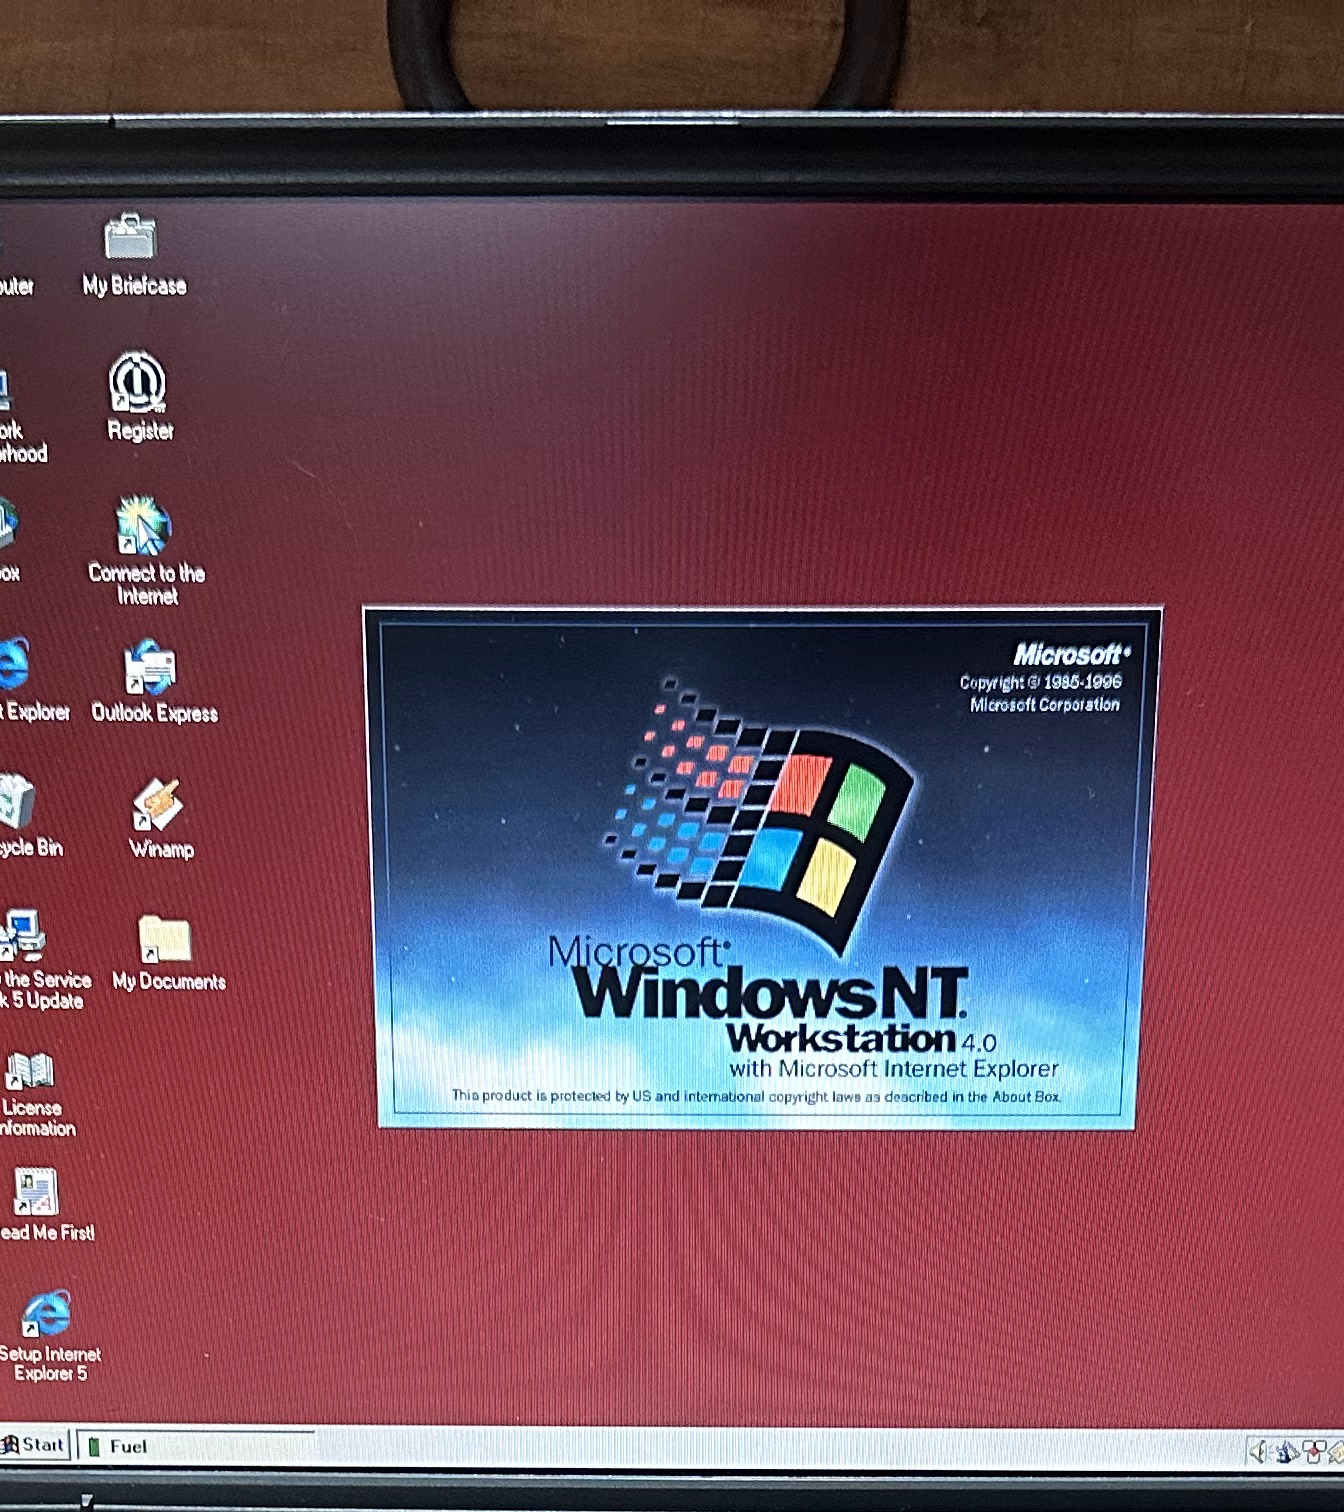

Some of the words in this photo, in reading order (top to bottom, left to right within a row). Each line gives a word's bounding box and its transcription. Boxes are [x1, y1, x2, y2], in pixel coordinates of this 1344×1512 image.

[83, 275, 107, 298] My
[112, 275, 187, 296] Briefcase
[107, 419, 174, 443] Register
[88, 561, 155, 583] Connect
[160, 563, 175, 583] to
[179, 562, 205, 583] the
[118, 586, 178, 606] Internet
[960, 673, 1025, 693] Copyright
[8, 702, 70, 725] Explorer
[92, 702, 153, 722] Outlook
[157, 702, 218, 725] Express
[970, 695, 1036, 712] Microsoft
[1039, 695, 1120, 714] Corporation
[37, 836, 64, 857] Bin
[128, 838, 194, 860] Winamp
[5, 970, 30, 988] the
[33, 970, 92, 989] Service
[112, 971, 135, 992] My
[139, 971, 226, 991] Documents
[12, 991, 23, 1008] 5
[28, 991, 83, 1011] Update
[571, 965, 877, 1019] Windows
[725, 1023, 956, 1053] Workstation
[961, 1033, 997, 1052] 4.0
[730, 1060, 772, 1078] with
[779, 1059, 878, 1078] Microsoft
[885, 1059, 967, 1078] Internet
[974, 1059, 1060, 1082] Explorer
[452, 1088, 479, 1101] This
[482, 1090, 532, 1104] product
[537, 1090, 547, 1101] is
[551, 1089, 610, 1104] protected
[615, 1090, 630, 1105] by
[632, 1090, 651, 1101] US
[655, 1090, 679, 1102] and
[684, 1090, 764, 1102] international
[769, 1091, 828, 1105] copyright
[832, 1091, 861, 1102] laws
[865, 1093, 880, 1102] as
[885, 1091, 947, 1102] described
[952, 1091, 964, 1102] in
[968, 1091, 987, 1102] the
[993, 1091, 1031, 1102] About
[2, 1098, 62, 1116] License
[33, 1224, 57, 1240] Me
[61, 1224, 95, 1242] First!
[45, 1345, 101, 1362] Internet
[14, 1365, 73, 1382] Explorer
[77, 1365, 88, 1381] 5
[22, 1437, 64, 1454] Start
[111, 1439, 147, 1455] Fuel
